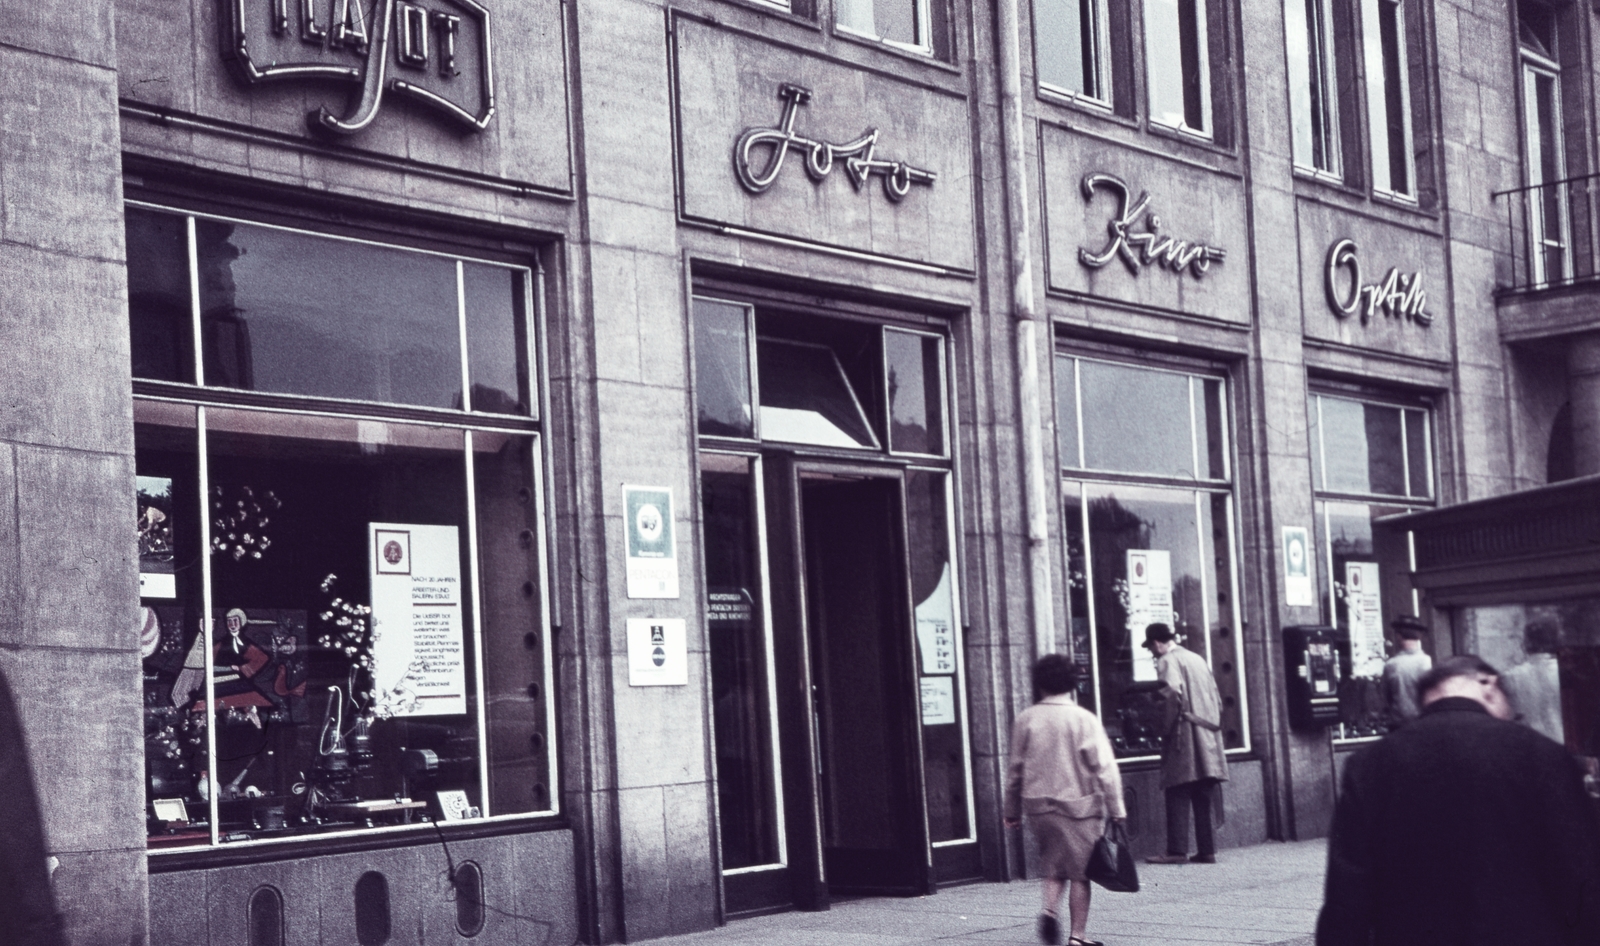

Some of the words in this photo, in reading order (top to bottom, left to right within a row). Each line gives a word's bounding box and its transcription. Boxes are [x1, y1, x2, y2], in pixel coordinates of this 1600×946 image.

[1079, 173, 1226, 276] Kino
[1324, 238, 1434, 327] Optik
[628, 568, 677, 581] PENTACON
